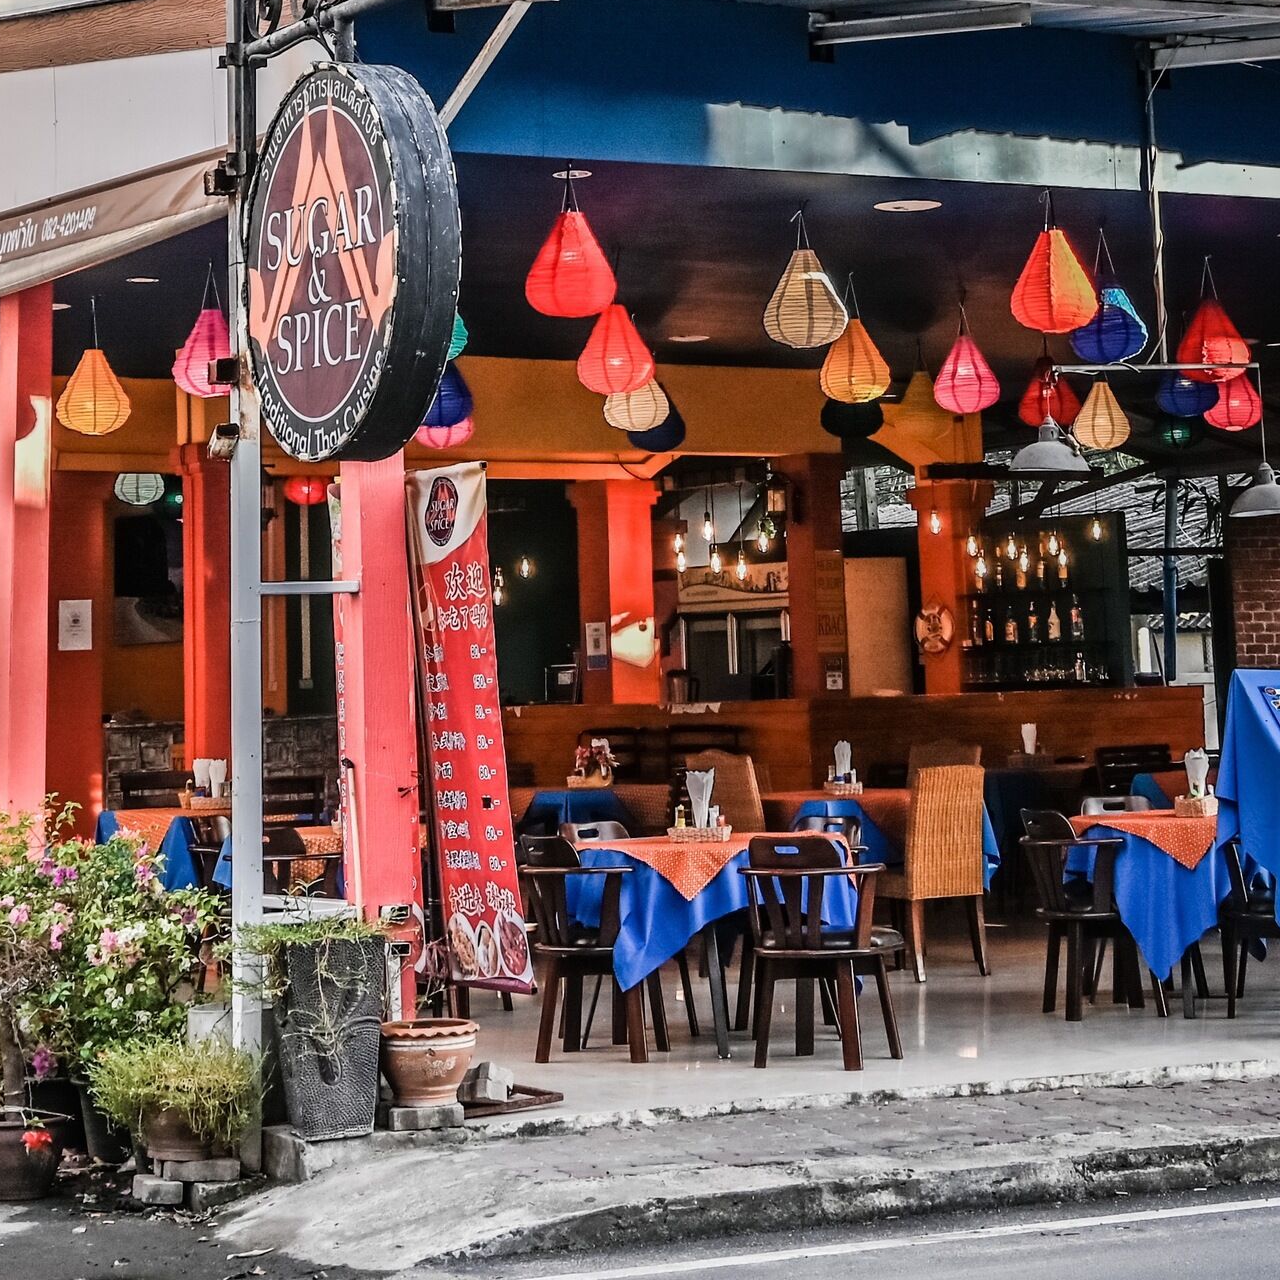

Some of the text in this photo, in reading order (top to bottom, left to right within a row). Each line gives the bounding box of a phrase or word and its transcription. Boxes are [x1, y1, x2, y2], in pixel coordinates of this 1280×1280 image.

[266, 183, 377, 272] SUGAR
[306, 246, 333, 306] &
[276, 298, 363, 376] SPICE
[259, 350, 382, 456] Traditional Thai Cuisine
[431, 498, 455, 513] SUGAR
[444, 561, 487, 601] 欢迎
